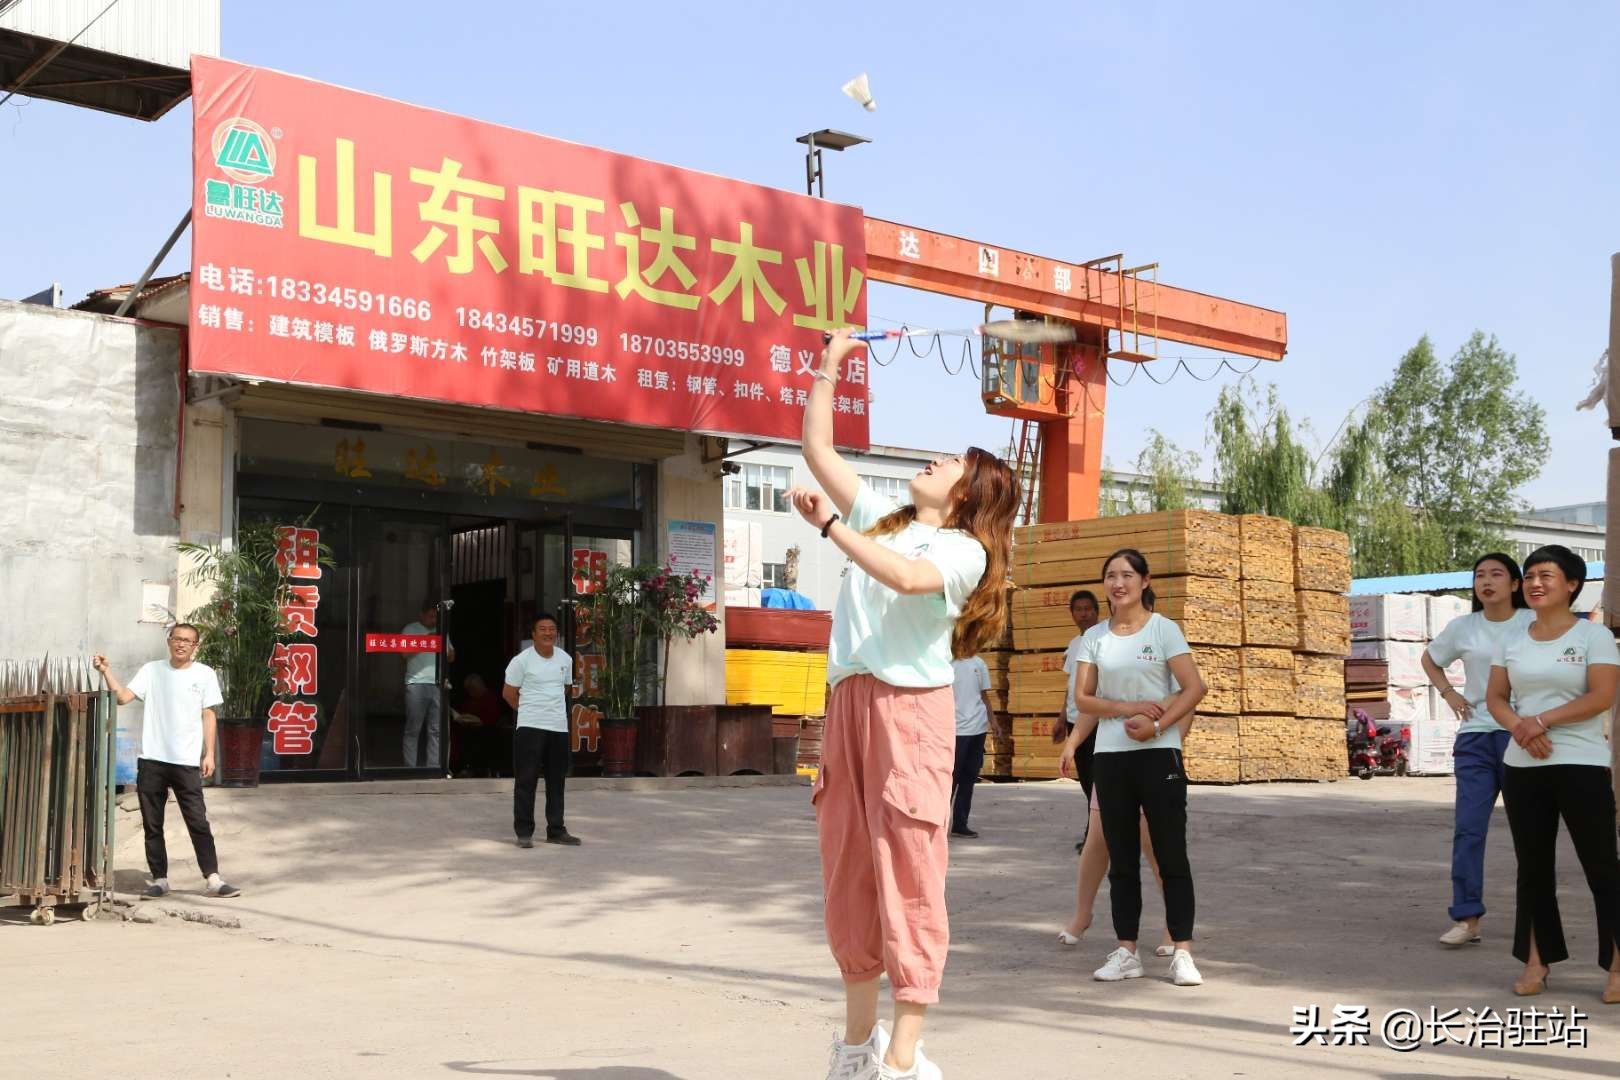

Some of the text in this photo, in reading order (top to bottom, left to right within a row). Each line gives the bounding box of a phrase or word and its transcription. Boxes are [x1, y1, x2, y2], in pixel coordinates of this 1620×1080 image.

[205, 179, 284, 217] 鲁旺达
[206, 205, 284, 228] LUWANGDA
[298, 137, 866, 332] 山东旺达木业
[269, 314, 356, 347] 建筑模板
[368, 328, 468, 363] 俄罗斯方木
[481, 346, 536, 373] 竹架板
[547, 356, 617, 383] 矿用道木
[455, 306, 598, 348] 18434571999
[619, 332, 745, 367] 18703553999
[770, 344, 866, 385] 德义店
